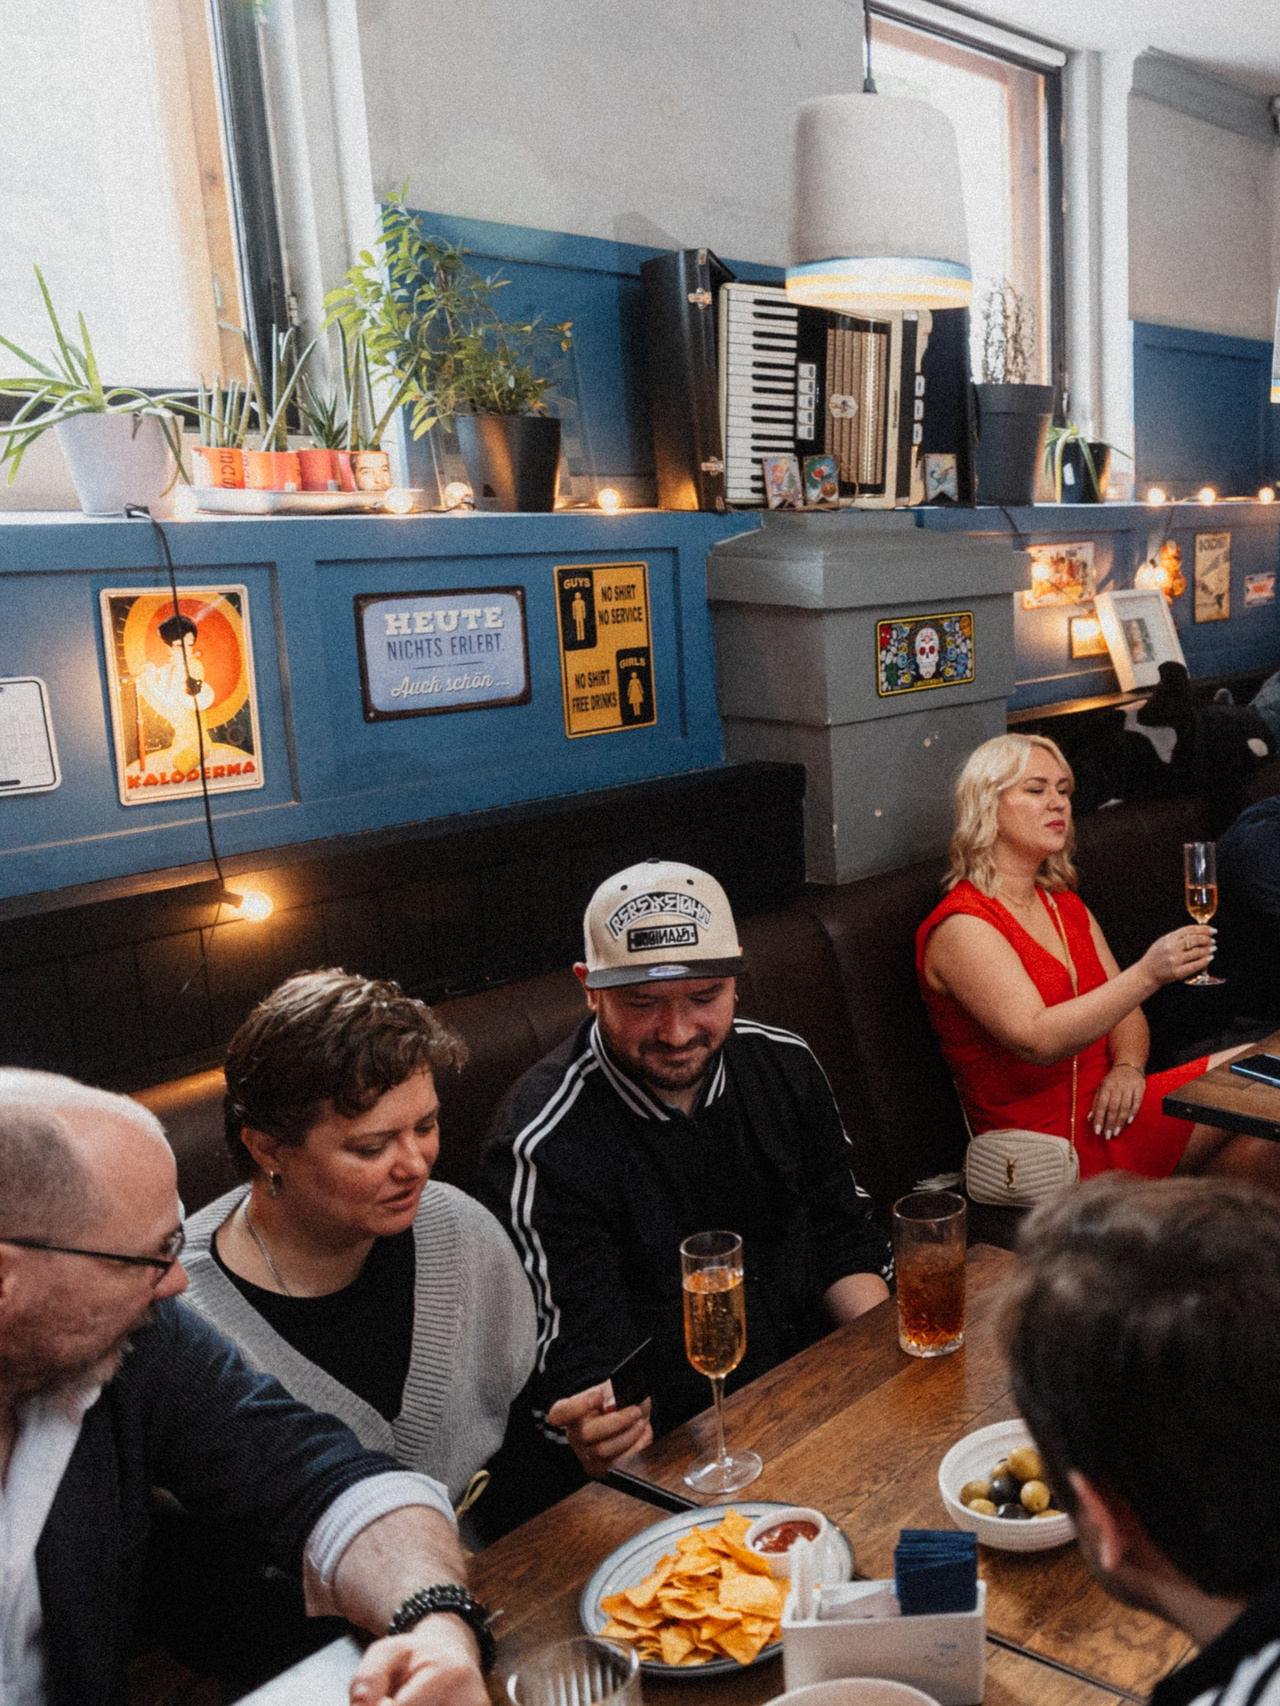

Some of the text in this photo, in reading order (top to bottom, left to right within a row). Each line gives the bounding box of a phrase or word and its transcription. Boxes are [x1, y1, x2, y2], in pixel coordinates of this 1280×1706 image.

[563, 577, 591, 590] GUYS
[601, 584, 636, 602] NO SHIRT
[385, 606, 504, 636] HEUTE
[598, 606, 643, 626] NO SERVICE
[387, 633, 505, 662] NICHTS ERLEBT.
[619, 657, 646, 669] GIRLS
[391, 675, 442, 699] Auch
[574, 669, 611, 690] NO SHIRT
[572, 691, 617, 714] FREE DRINKS
[126, 760, 256, 790] KALODERMA
